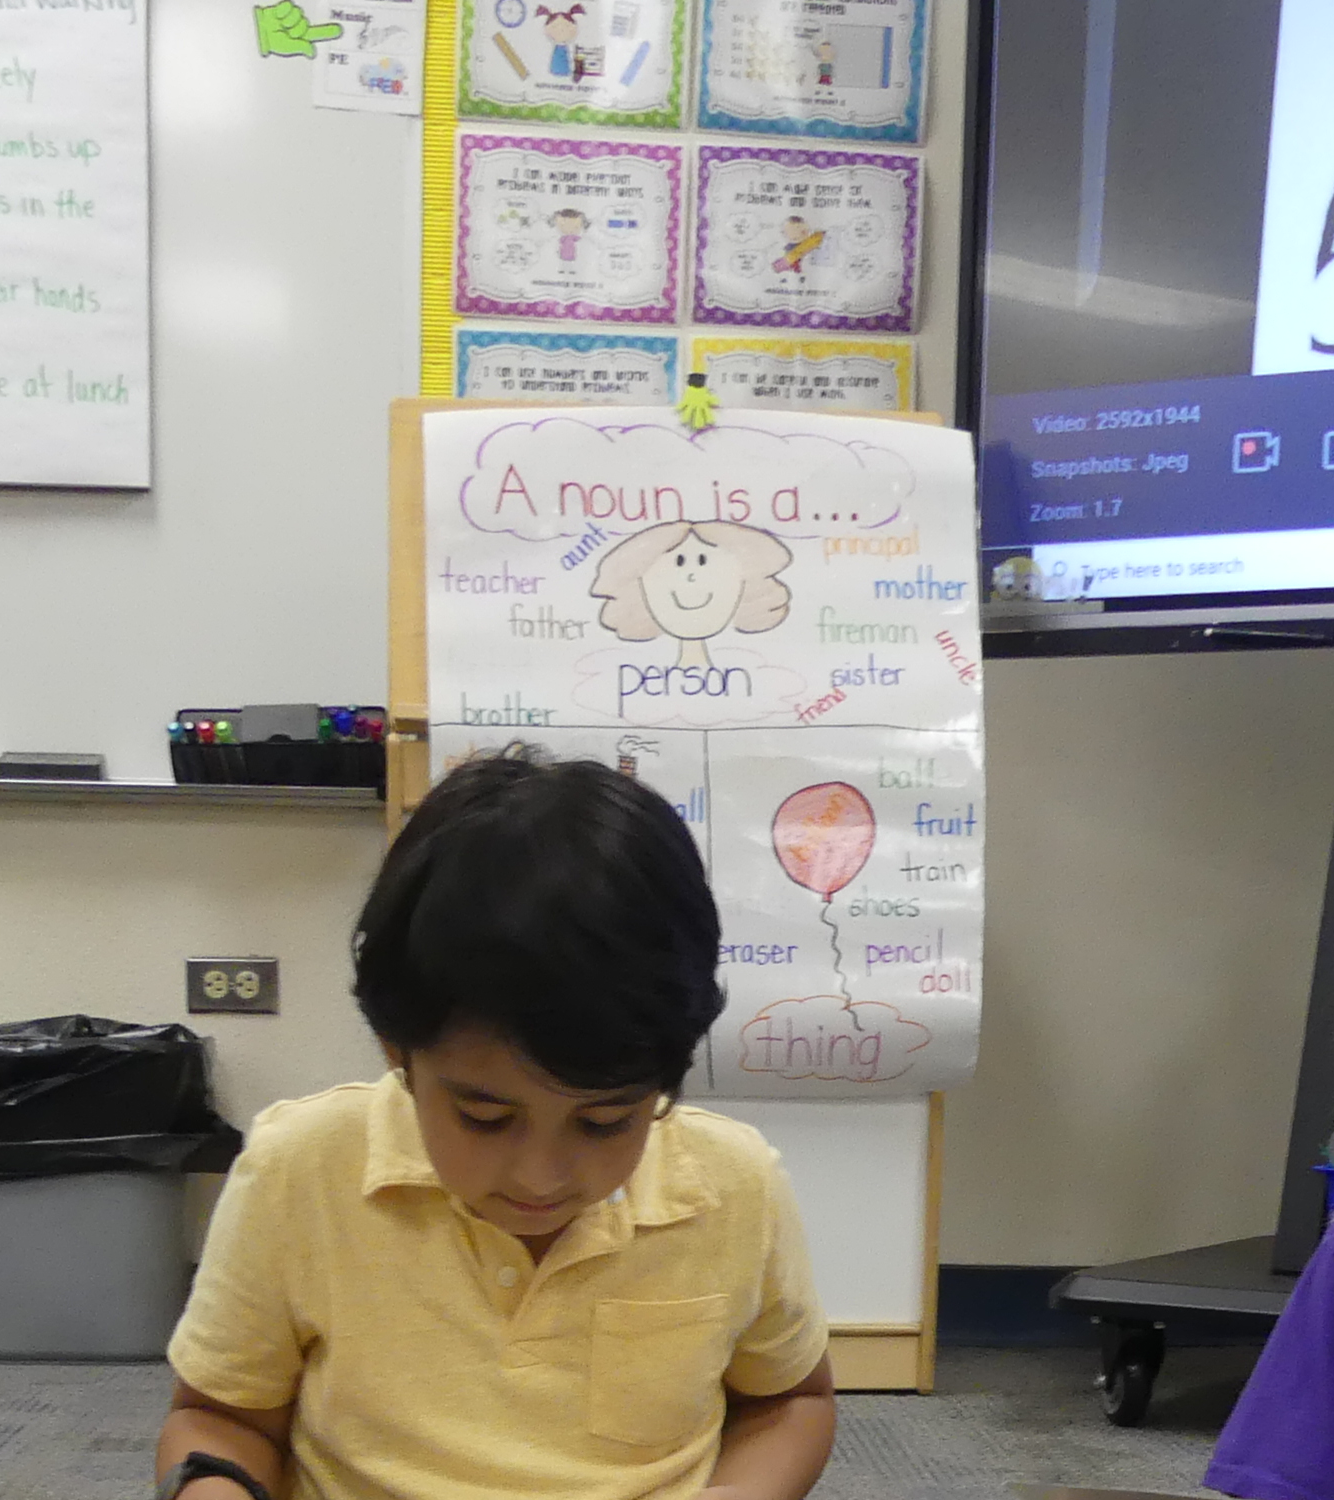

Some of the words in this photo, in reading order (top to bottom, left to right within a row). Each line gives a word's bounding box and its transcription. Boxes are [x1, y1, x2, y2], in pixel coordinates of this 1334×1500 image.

[68, 138, 102, 167] up
[21, 197, 46, 217] in
[54, 189, 95, 218] the
[31, 276, 102, 314] hands
[23, 363, 54, 399] at
[67, 369, 129, 404] lunch
[1096, 405, 1201, 430] 2592x1944
[1142, 453, 1190, 475] Jpeg
[494, 464, 538, 517] A
[559, 481, 684, 521] noun
[712, 480, 751, 522] is
[1094, 499, 1123, 518] 1.7
[560, 522, 610, 571] aunt
[822, 530, 921, 565] principal
[439, 557, 546, 595] teacher
[874, 564, 969, 600] mother
[1080, 564, 1120, 582] Type
[1125, 562, 1162, 578] here
[1167, 562, 1184, 576] to
[1188, 558, 1245, 576] search
[508, 603, 590, 641] father
[816, 605, 919, 644] fireman
[831, 653, 906, 687] sister
[935, 630, 977, 686] uncle
[618, 663, 752, 718] person
[794, 686, 847, 725] friend
[461, 691, 557, 725] brother
[879, 757, 936, 789] ball
[913, 803, 977, 836] fruit
[899, 851, 965, 882] train
[848, 885, 921, 917] shoes
[717, 943, 799, 965] eraser
[865, 928, 944, 976] pencil
[920, 964, 971, 993] doll
[756, 1017, 882, 1078] thing
